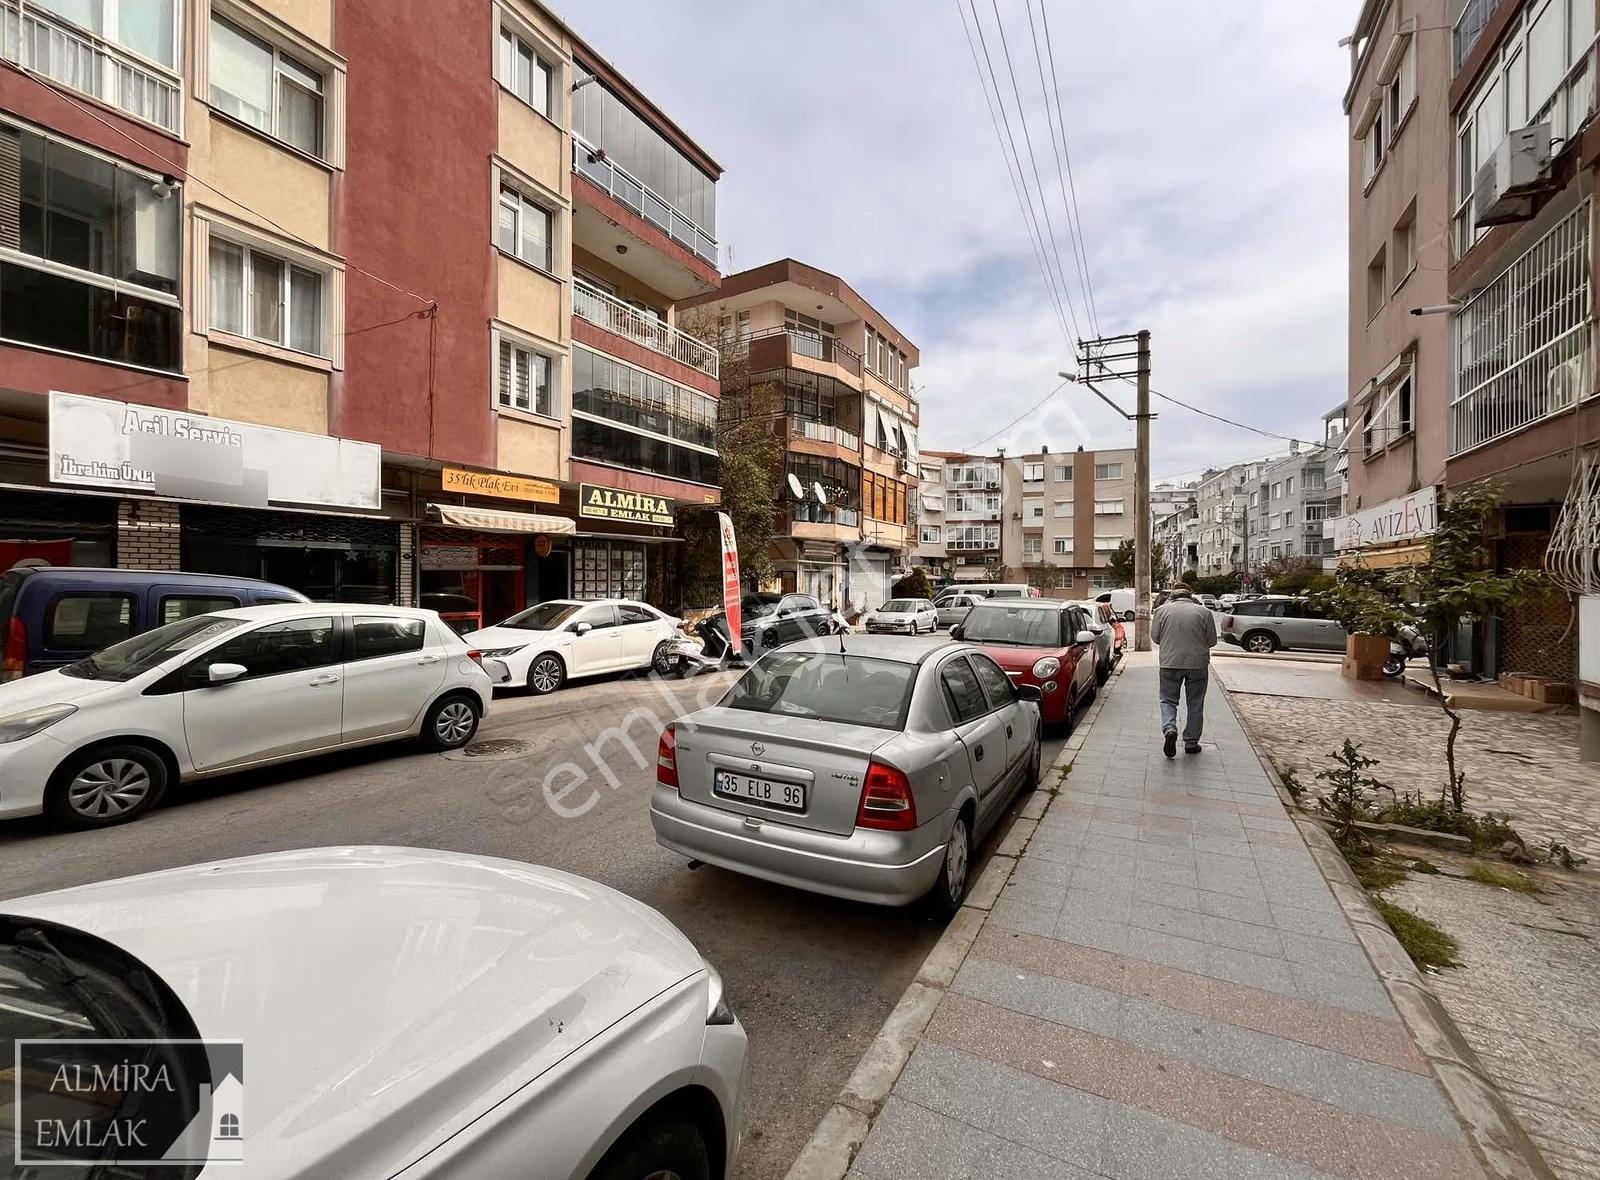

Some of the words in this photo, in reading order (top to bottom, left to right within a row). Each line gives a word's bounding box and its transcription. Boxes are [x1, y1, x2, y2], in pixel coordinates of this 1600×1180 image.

[174, 418, 242, 447] Servis
[61, 455, 120, 480] İbrahim
[588, 489, 669, 515] ALMİRA
[610, 508, 651, 521] EMLAK
[723, 774, 738, 792] 35
[748, 780, 771, 799] ELB
[783, 786, 800, 804] 96
